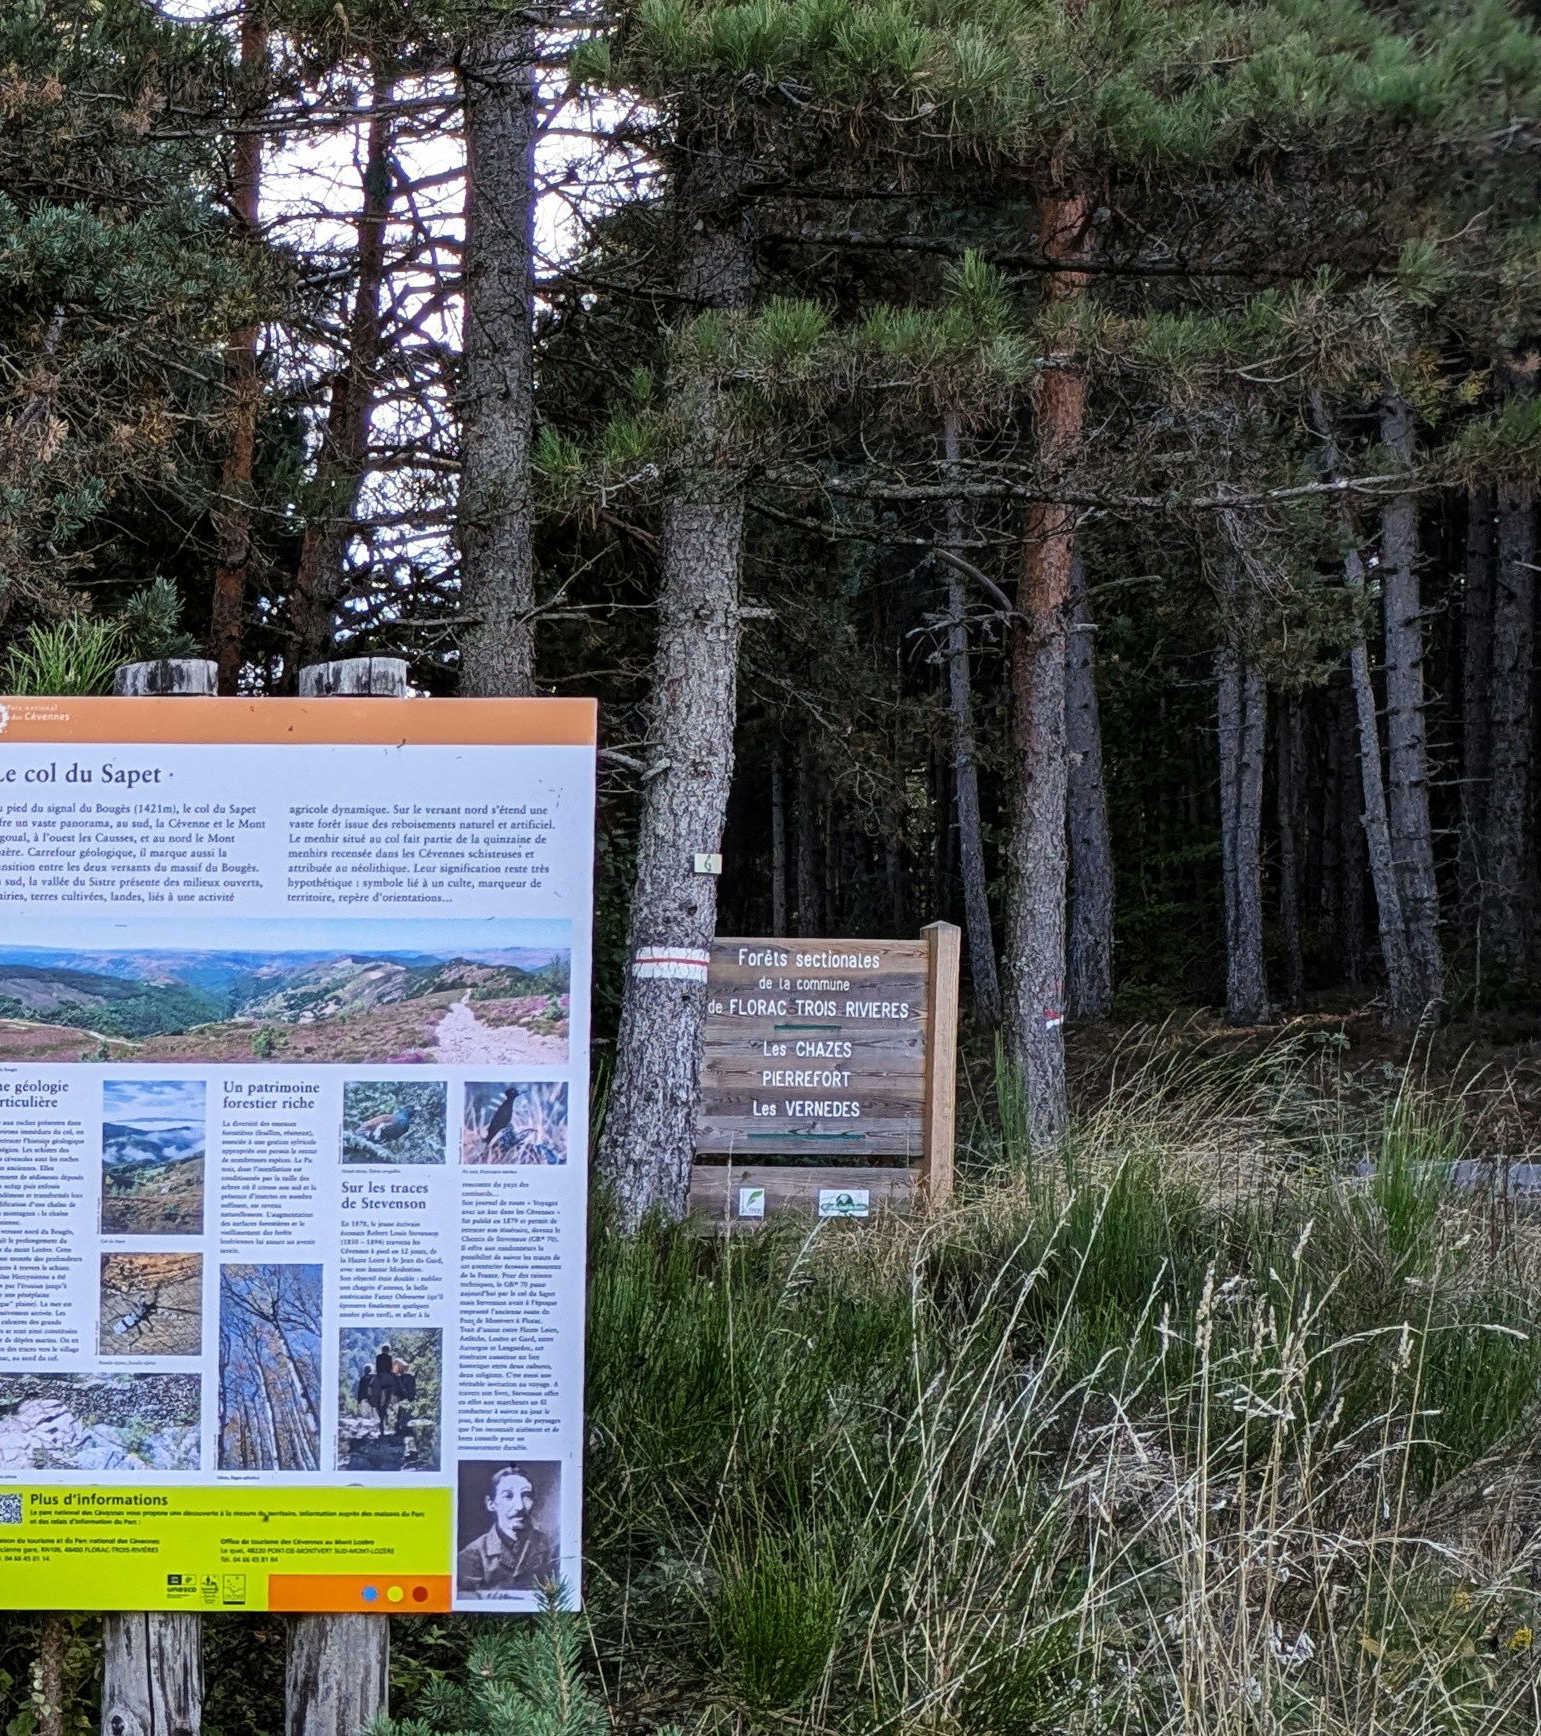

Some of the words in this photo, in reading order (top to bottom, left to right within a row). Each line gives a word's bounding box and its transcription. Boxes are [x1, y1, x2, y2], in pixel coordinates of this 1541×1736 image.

[24, 712, 70, 722] Cévennes
[24, 762, 56, 782] col
[65, 762, 92, 783] du
[101, 763, 161, 788] Sapet
[6, 802, 27, 815] pied
[30, 803, 43, 813] du
[47, 802, 75, 815] signal
[79, 803, 92, 813] du
[95, 803, 130, 815] Bougès
[133, 803, 179, 814] (1421m),
[182, 803, 191, 813] le
[194, 803, 209, 813] col
[212, 803, 225, 813] du
[229, 803, 256, 816] Sapet
[738, 948, 788, 967] Forêts
[796, 950, 880, 968] sectionales
[759, 977, 773, 989] de
[779, 977, 791, 989] la
[797, 980, 851, 991] commune
[707, 1000, 723, 1013] de
[729, 998, 787, 1016] FLORAC
[796, 999, 837, 1017] TROIS
[846, 1000, 909, 1018] RIVIERES
[763, 1041, 787, 1057] Les
[796, 1041, 852, 1058] CHAZES
[14, 1079, 68, 1095] géologie
[762, 1071, 851, 1087] PIERREFORT
[223, 1081, 242, 1098] Un
[247, 1081, 319, 1098] patrimoine
[222, 1094, 277, 1108] forestier
[282, 1096, 314, 1108] riche
[753, 1100, 777, 1117] Les
[785, 1100, 860, 1117] VERNEDES
[341, 1181, 363, 1193] Sur
[368, 1181, 385, 1193] les
[390, 1184, 428, 1193] traces
[341, 1196, 356, 1208] de
[361, 1197, 426, 1209] Stevenson
[30, 1493, 58, 1505] Plus
[63, 1493, 168, 1505] d'informations
